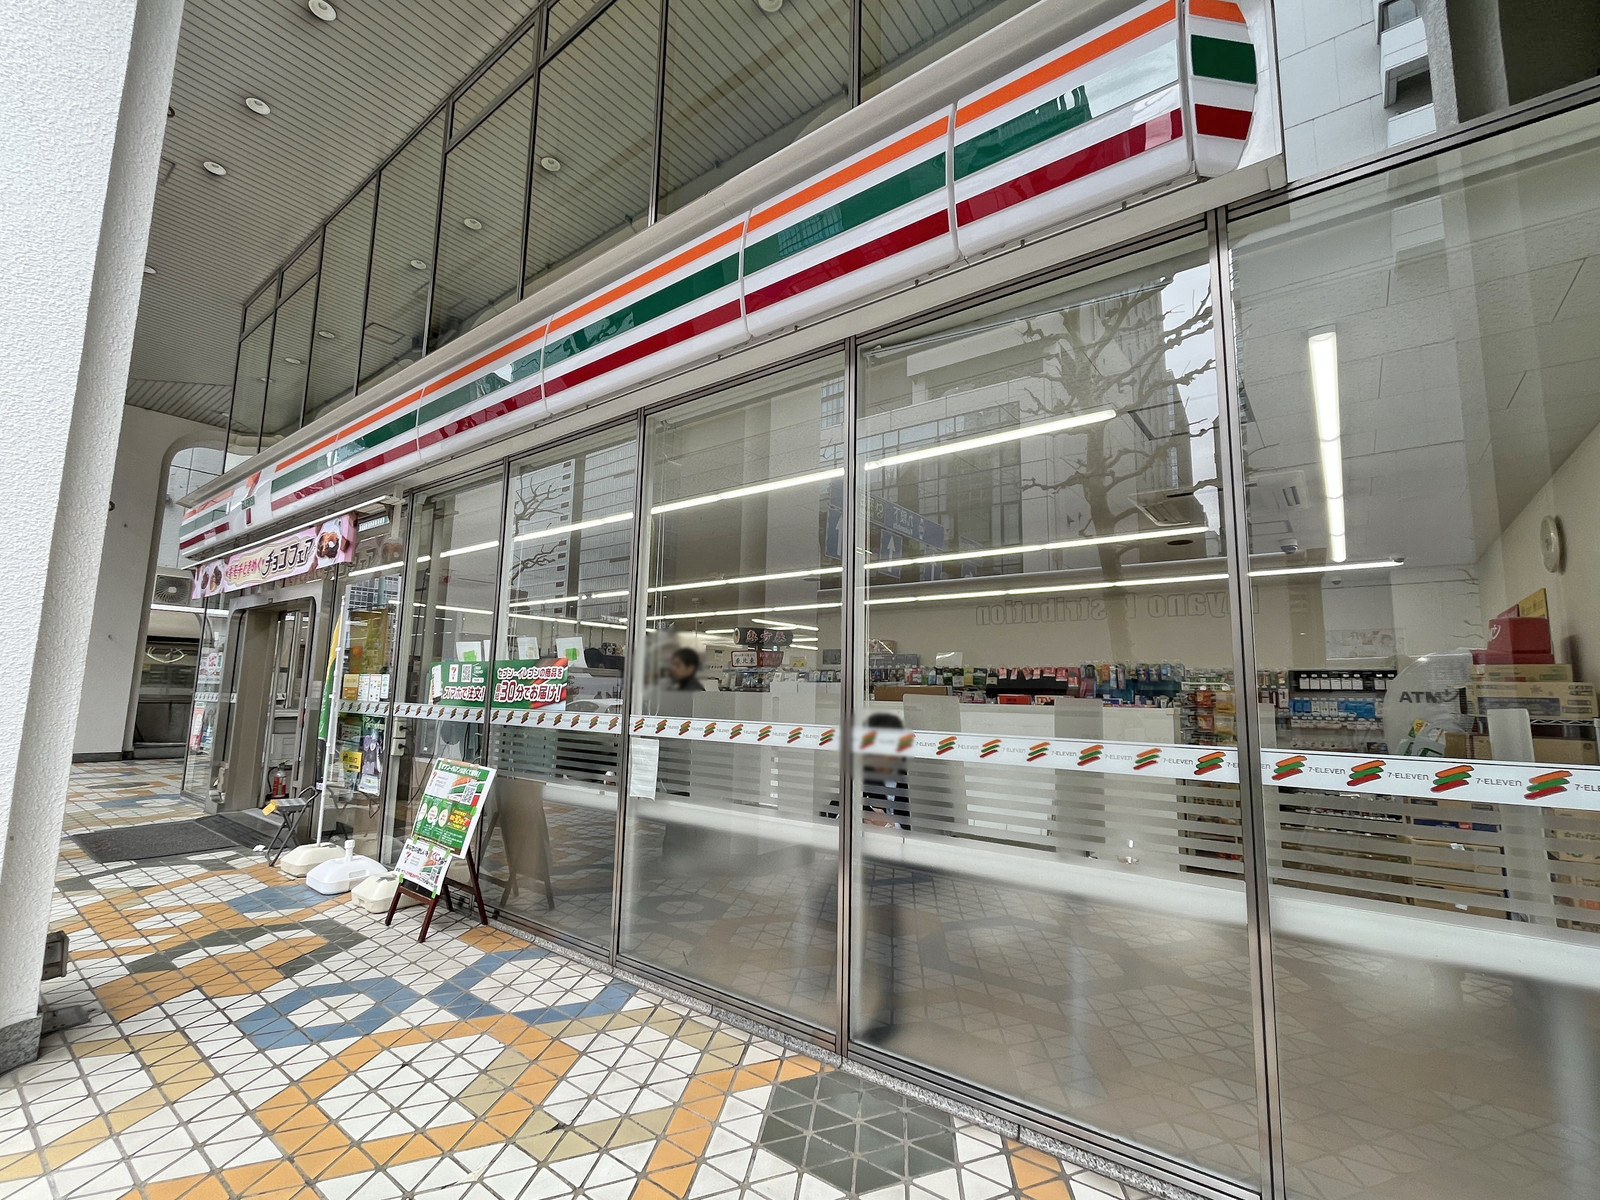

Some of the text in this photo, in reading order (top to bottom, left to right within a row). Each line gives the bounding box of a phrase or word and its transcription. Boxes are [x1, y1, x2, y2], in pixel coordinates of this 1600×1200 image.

[261, 538, 314, 576] チョコフェア
